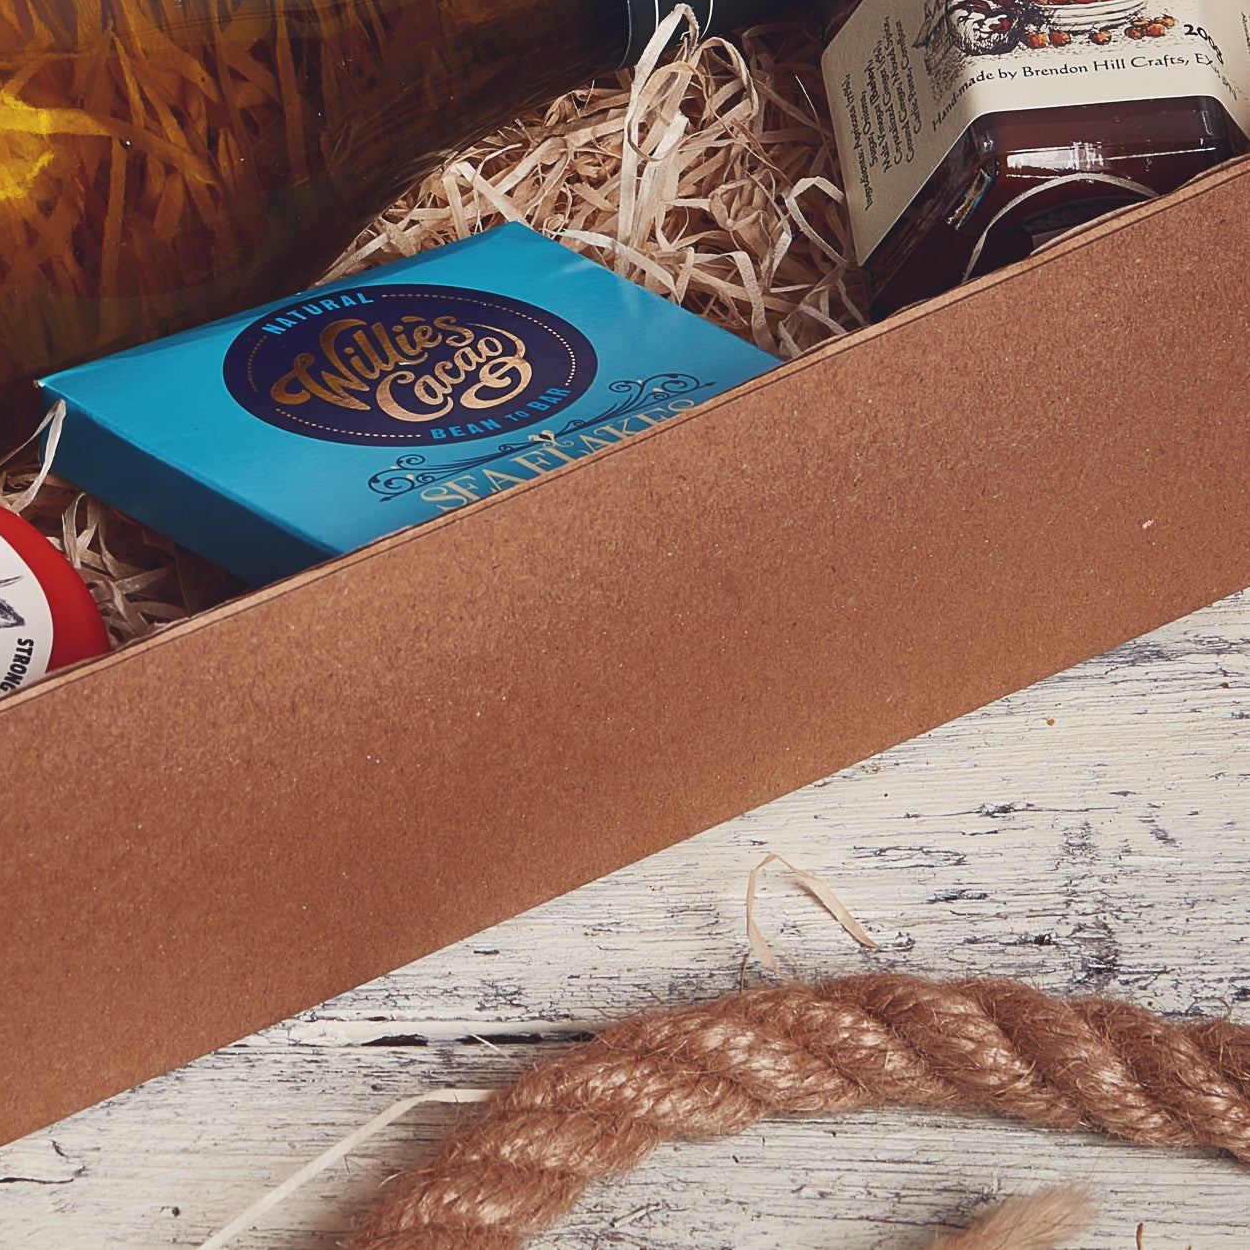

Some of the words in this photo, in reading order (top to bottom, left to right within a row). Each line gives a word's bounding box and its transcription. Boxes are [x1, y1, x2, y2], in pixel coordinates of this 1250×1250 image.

[998, 68, 1018, 81] by
[1022, 63, 1088, 78] Brendon
[1092, 58, 1126, 72] Hill
[1130, 54, 1190, 68] Crafts,
[261, 292, 374, 336] NATURAL
[376, 328, 530, 422] Cacao
[430, 418, 503, 440] BEAN
[528, 386, 573, 418] BAR
